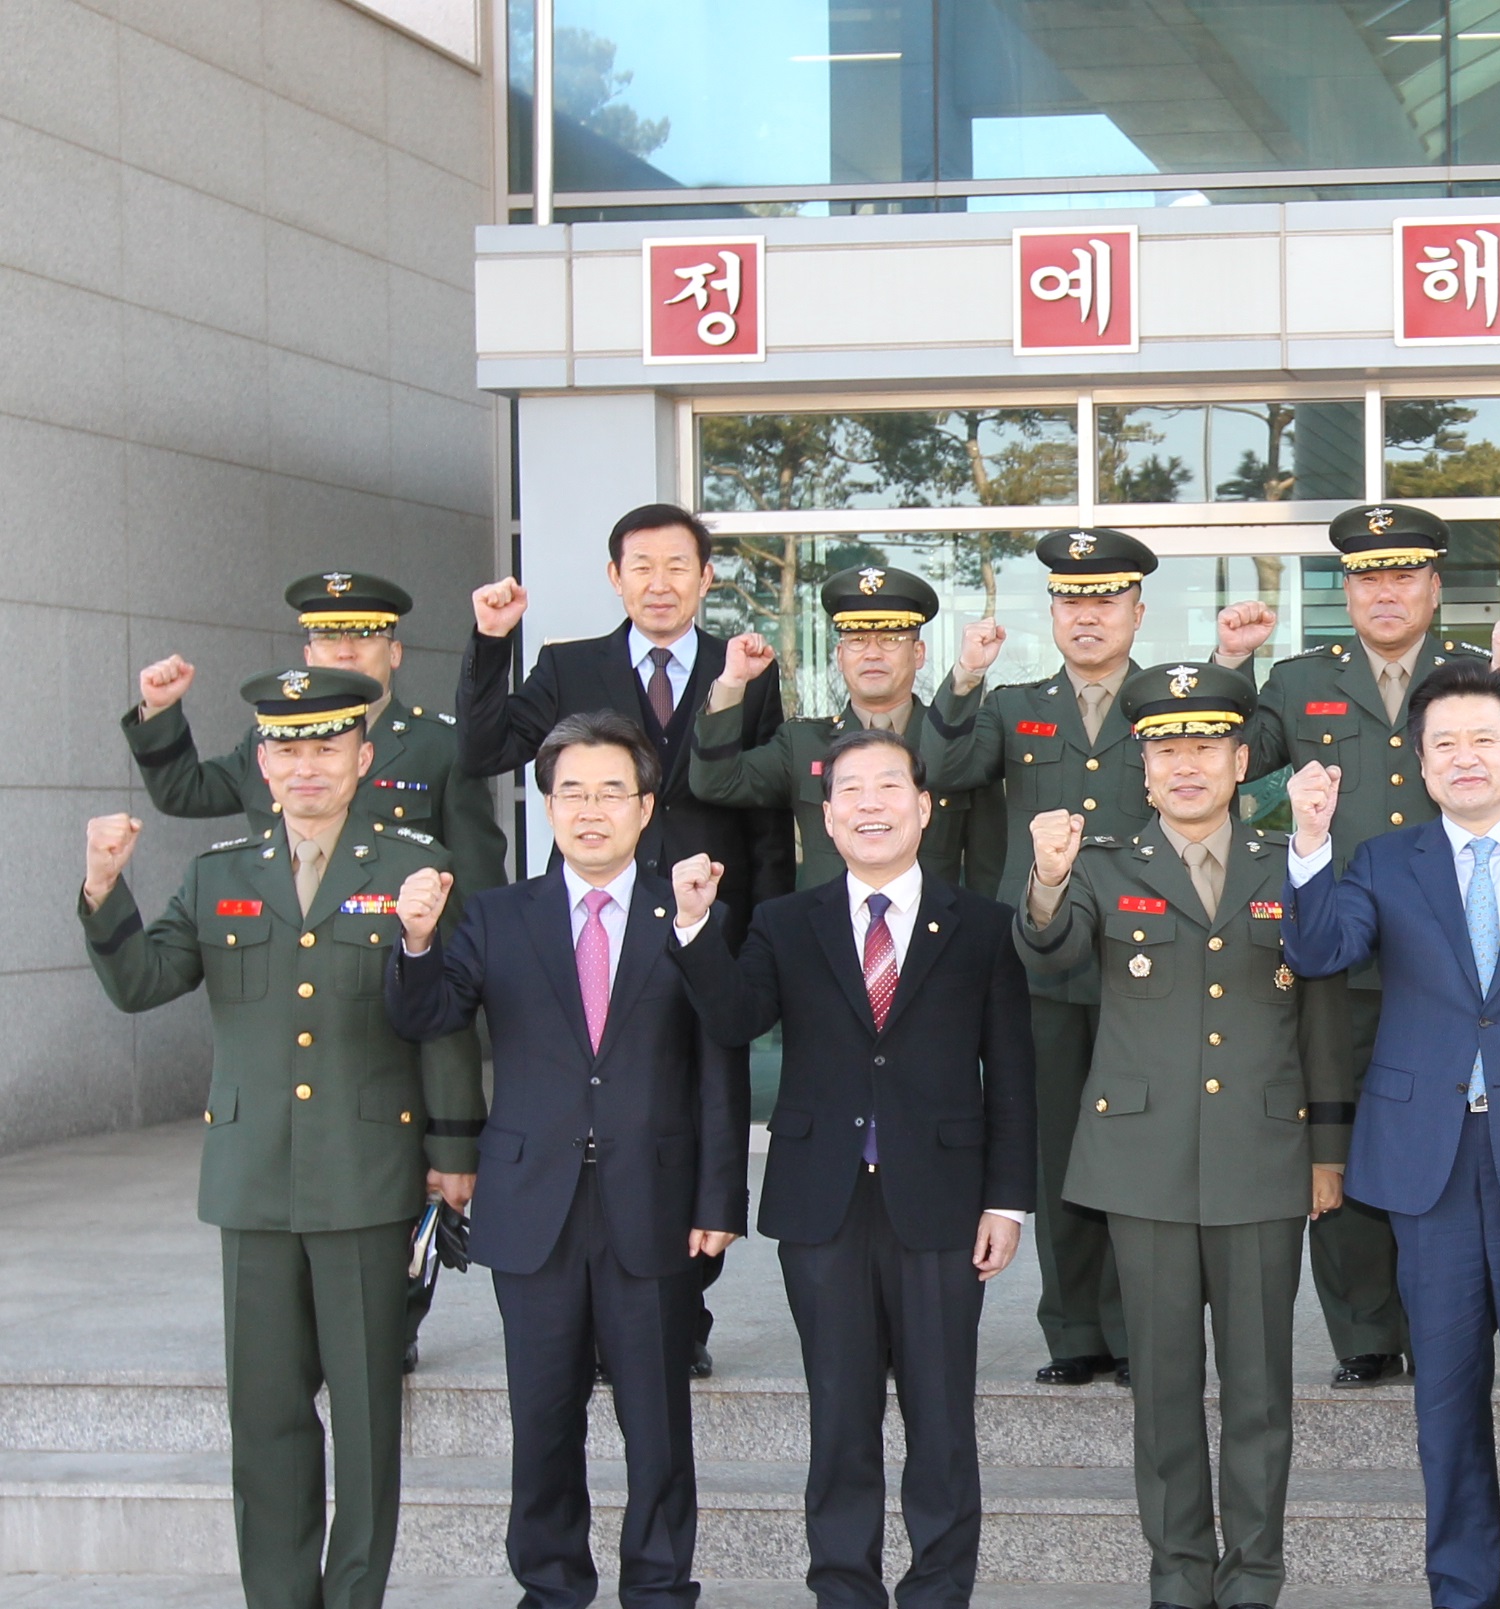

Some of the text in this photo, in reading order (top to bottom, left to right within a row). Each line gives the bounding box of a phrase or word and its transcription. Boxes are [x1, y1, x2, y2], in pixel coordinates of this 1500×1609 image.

[663, 250, 741, 346] 정
[1029, 238, 1111, 336] 예
[1415, 229, 1499, 328] 해
